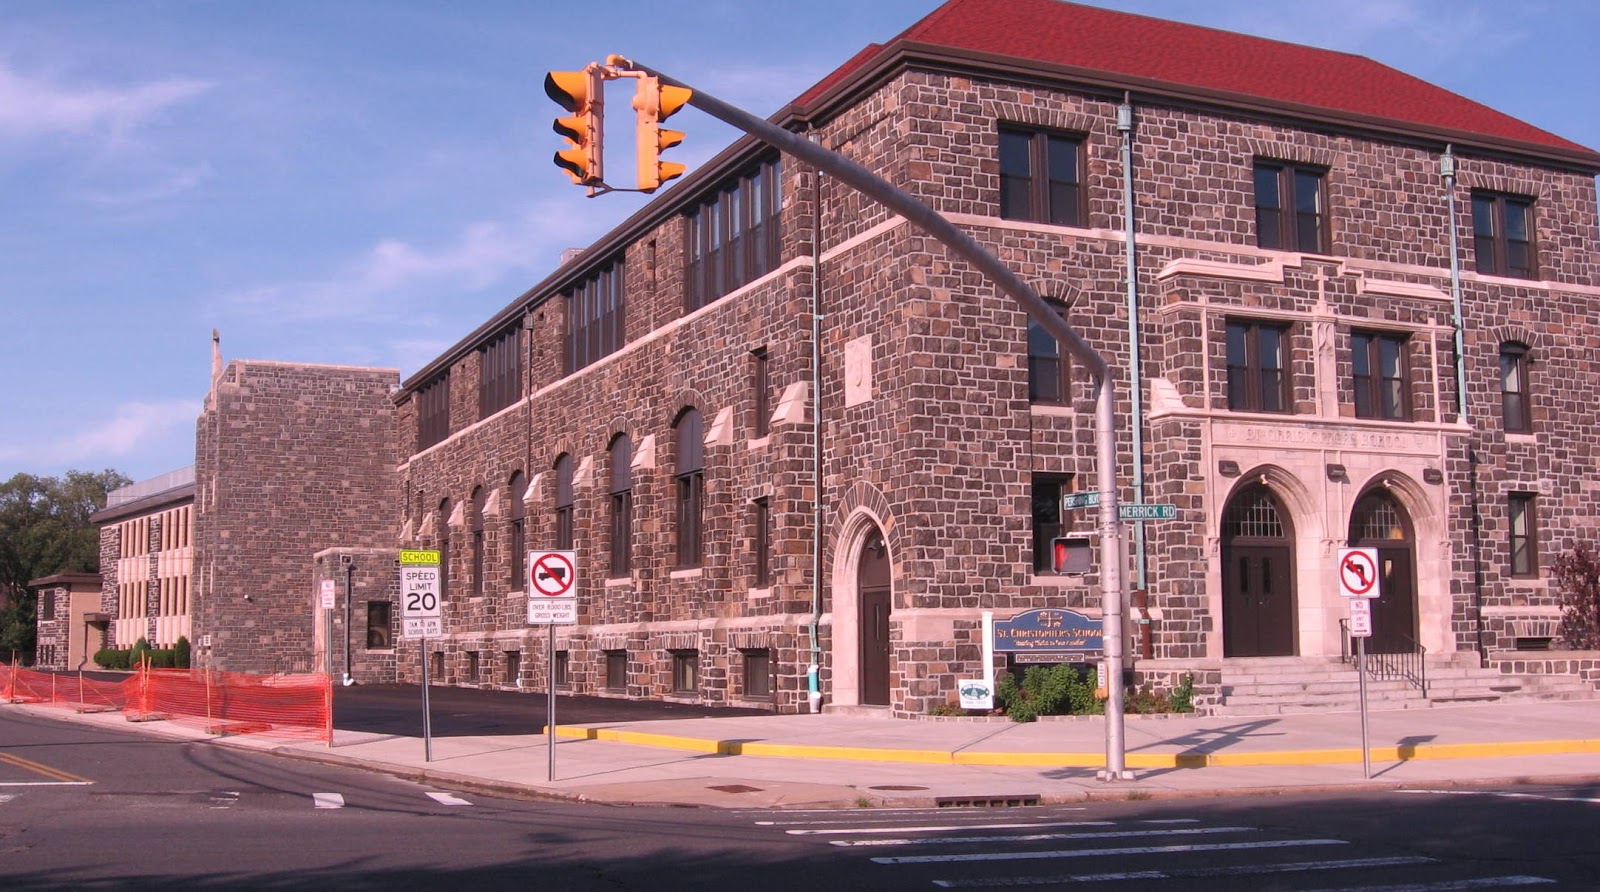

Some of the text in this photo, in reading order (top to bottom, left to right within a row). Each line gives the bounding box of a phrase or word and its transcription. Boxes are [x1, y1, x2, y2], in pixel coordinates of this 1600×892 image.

[1119, 506, 1175, 518] MERRICK RD
[403, 553, 437, 561] SCHOOL
[406, 572, 436, 580] SPEED
[409, 583, 432, 591] LIMIT
[407, 593, 436, 611] 20
[427, 627, 438, 635] DAYS
[1072, 628, 1104, 638] SCHOOL
